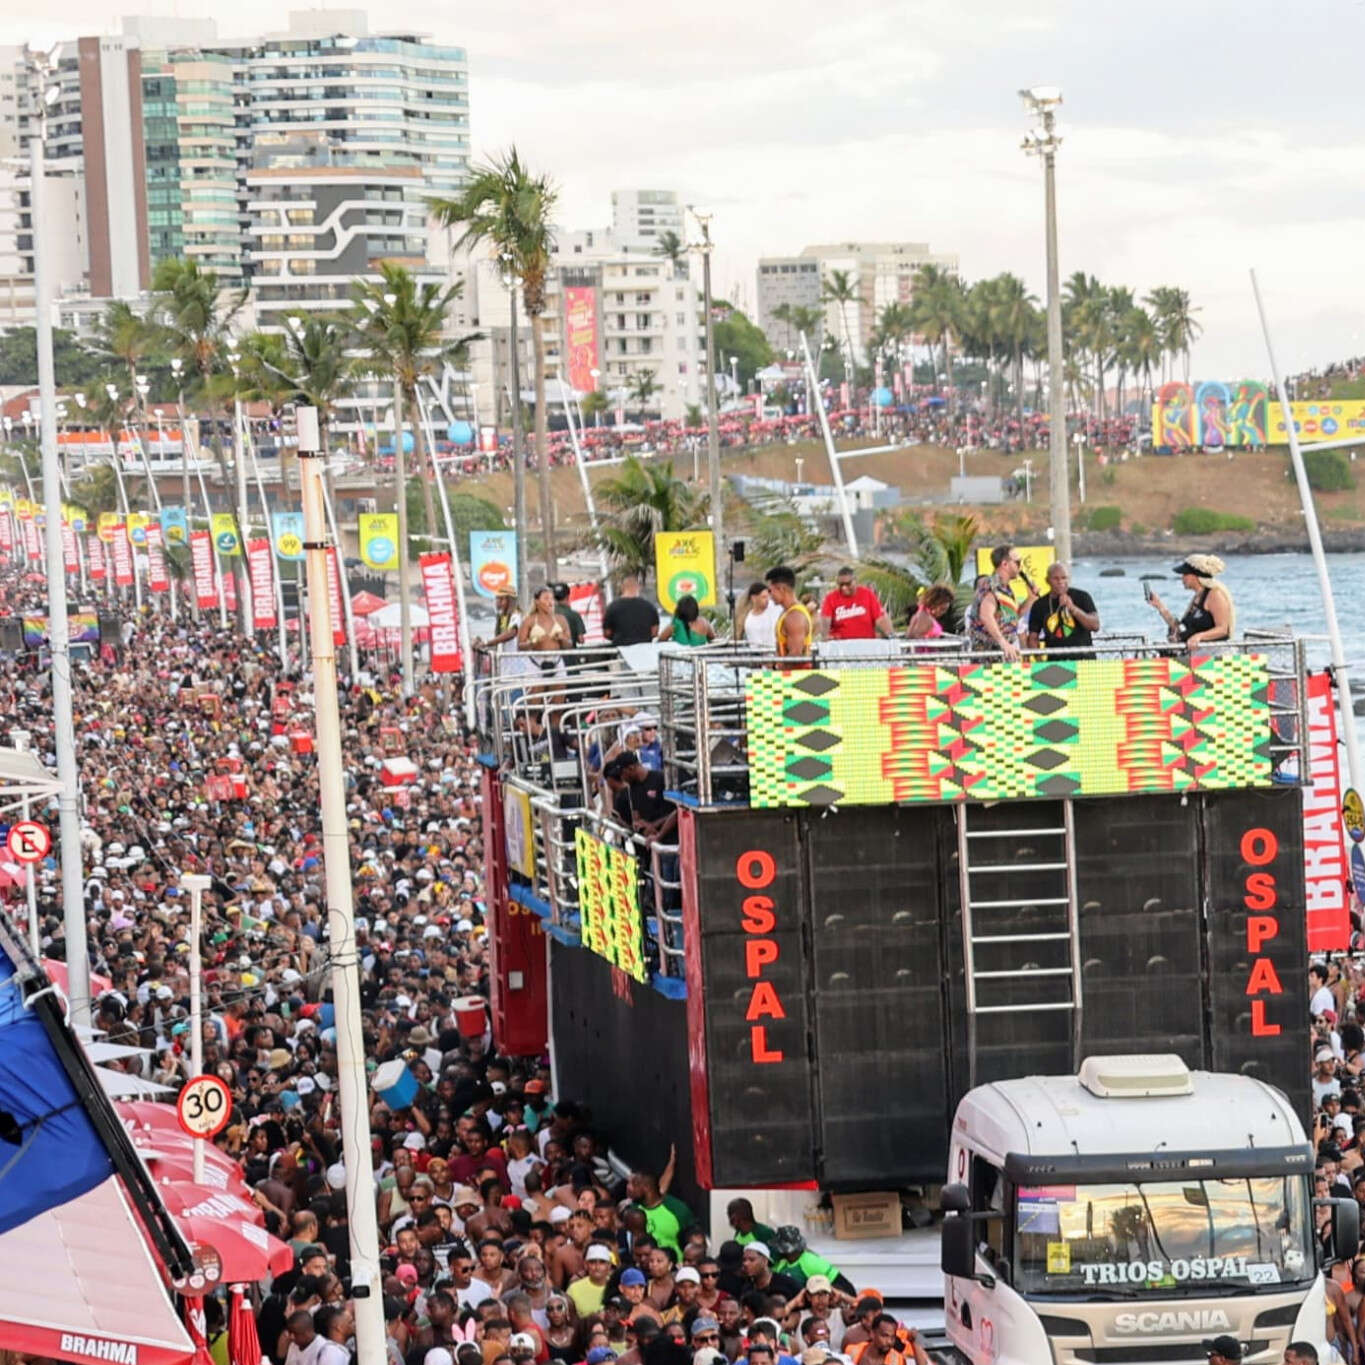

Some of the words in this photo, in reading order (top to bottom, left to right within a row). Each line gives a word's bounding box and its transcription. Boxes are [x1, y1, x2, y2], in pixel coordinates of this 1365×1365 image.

[249, 548, 274, 619] BRAHMA
[424, 562, 457, 655] BRAHMA
[735, 850, 786, 1064] OSPAL
[1240, 828, 1283, 1037] OSPAL
[187, 1086, 223, 1119] 30
[1081, 1261, 1163, 1285] TRIOS
[1172, 1256, 1252, 1281] OSPAL
[1114, 1308, 1231, 1334] SCANIA
